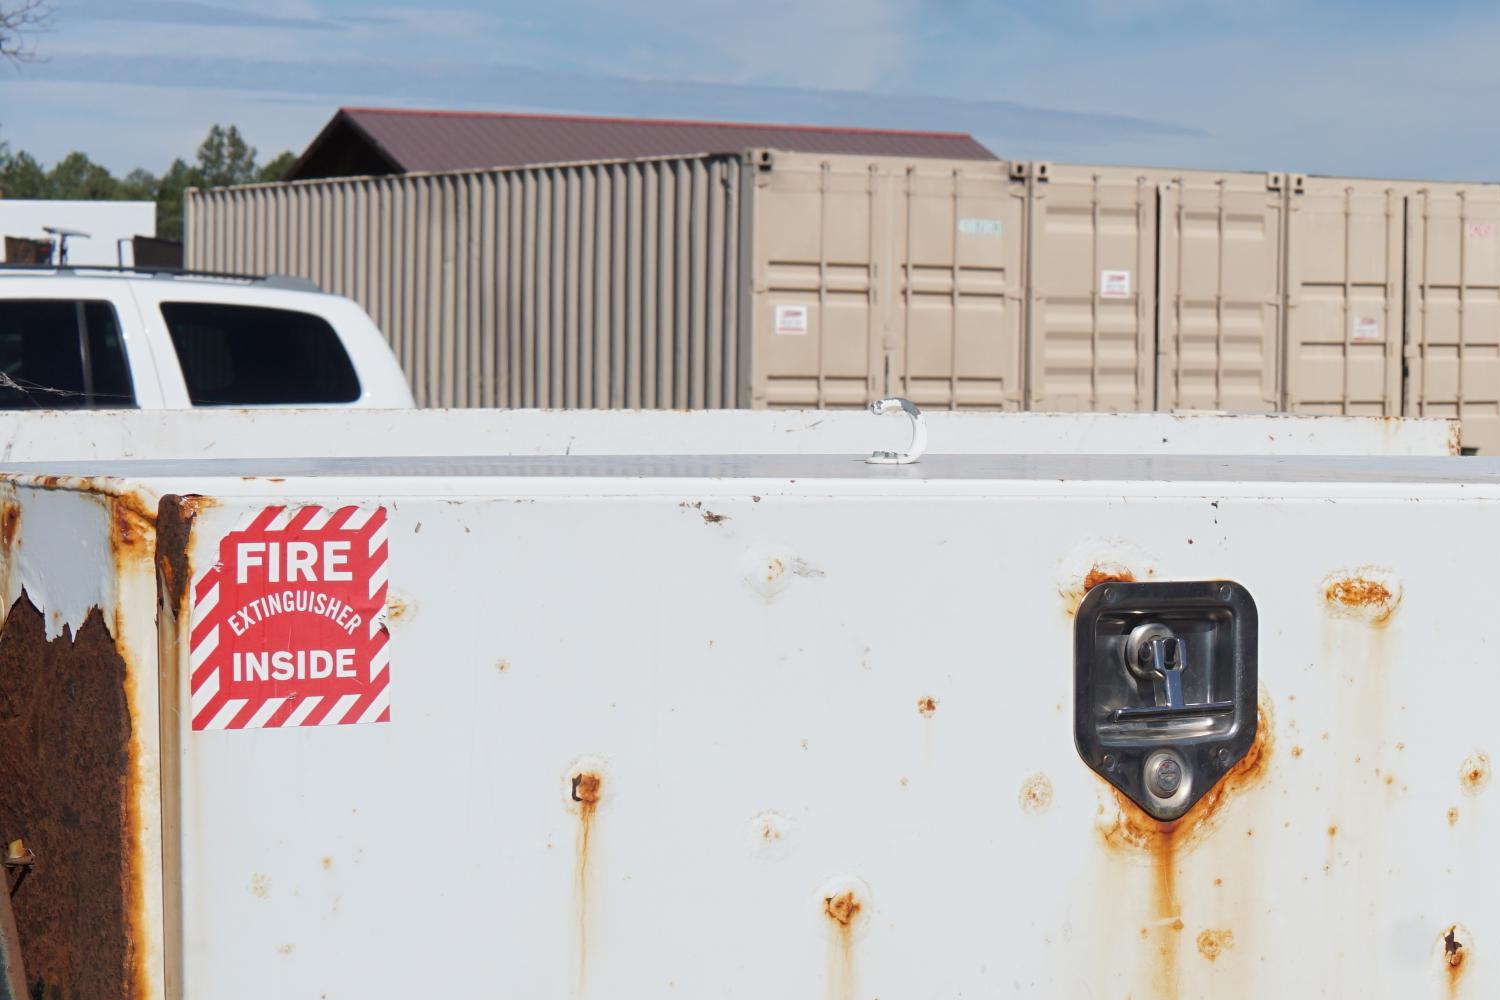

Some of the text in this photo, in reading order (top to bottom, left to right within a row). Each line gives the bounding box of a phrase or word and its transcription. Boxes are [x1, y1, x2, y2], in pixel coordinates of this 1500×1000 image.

[236, 541, 353, 584] FIRE
[227, 590, 362, 637] EXTINGUISHER
[233, 648, 357, 682] INSIDE
